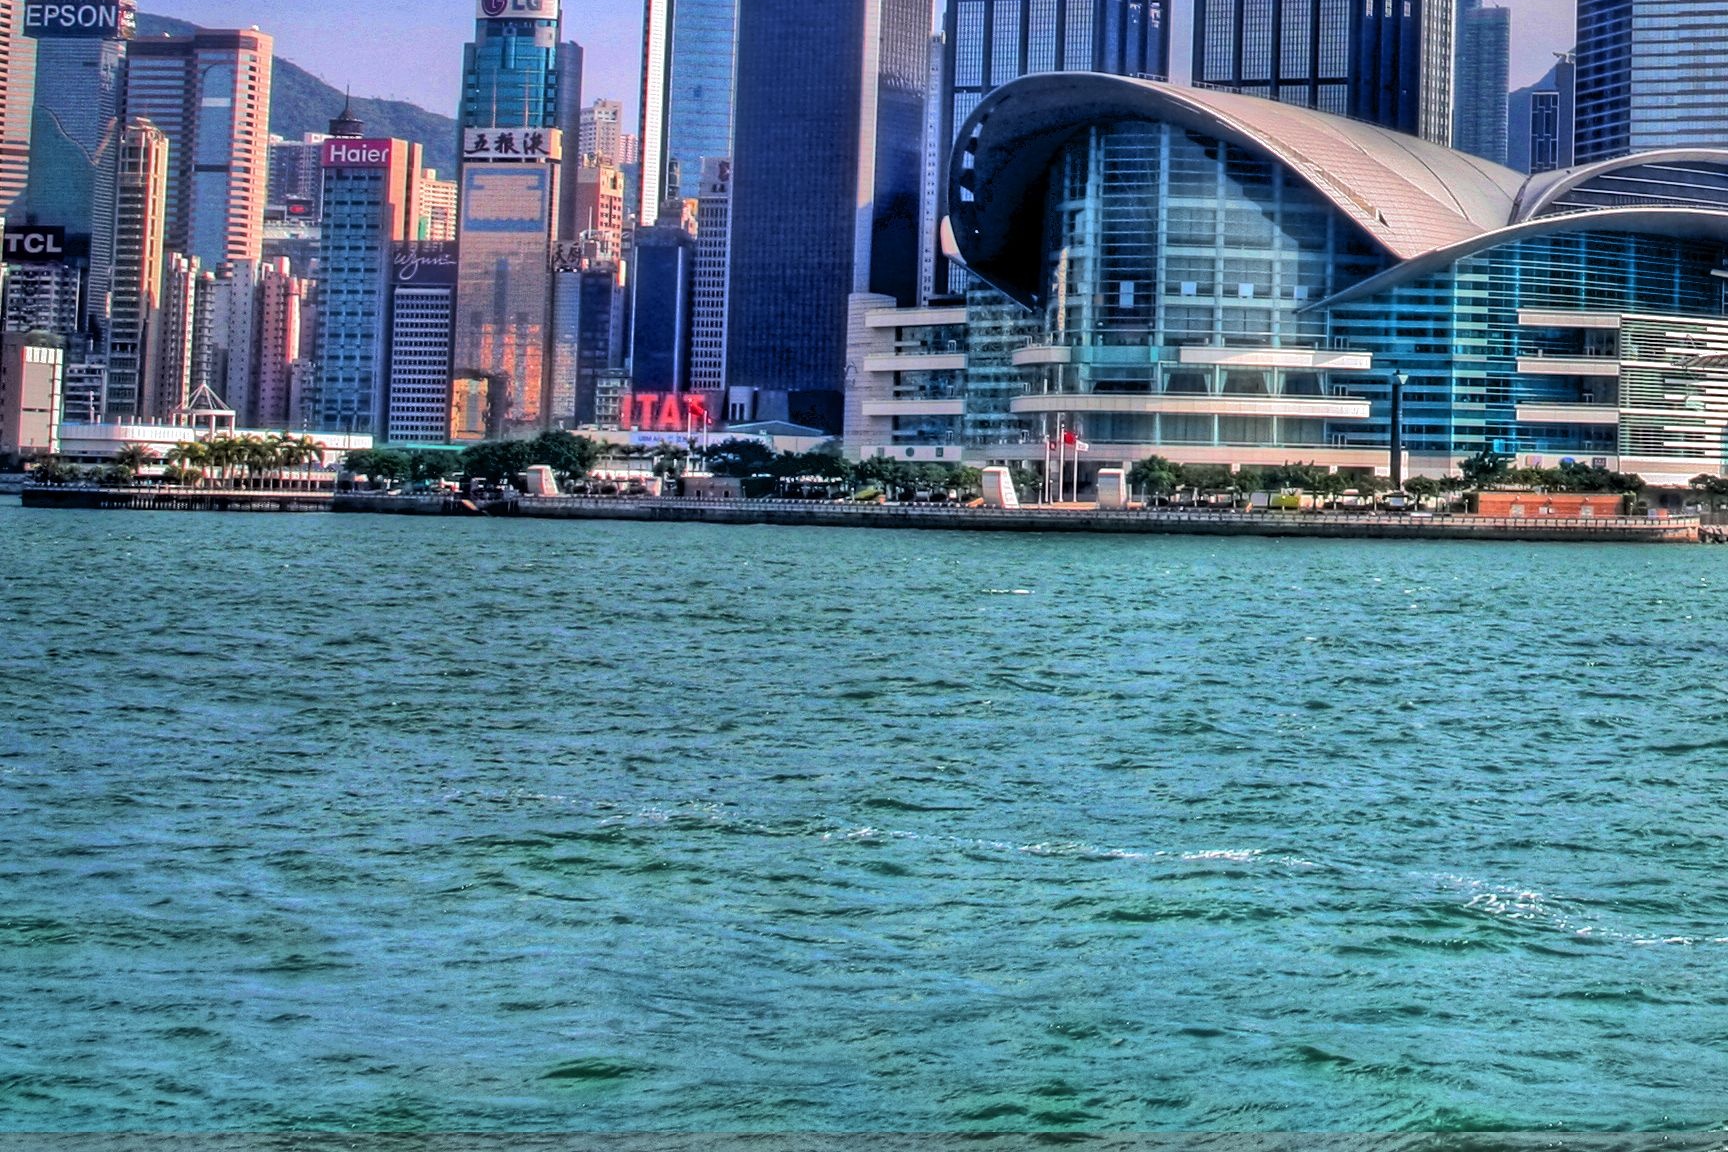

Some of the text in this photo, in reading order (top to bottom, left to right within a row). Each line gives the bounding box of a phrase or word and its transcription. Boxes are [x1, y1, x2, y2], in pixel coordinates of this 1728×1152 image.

[25, 4, 116, 27] EPSON
[329, 144, 389, 163] Haier
[4, 232, 63, 254] TCL
